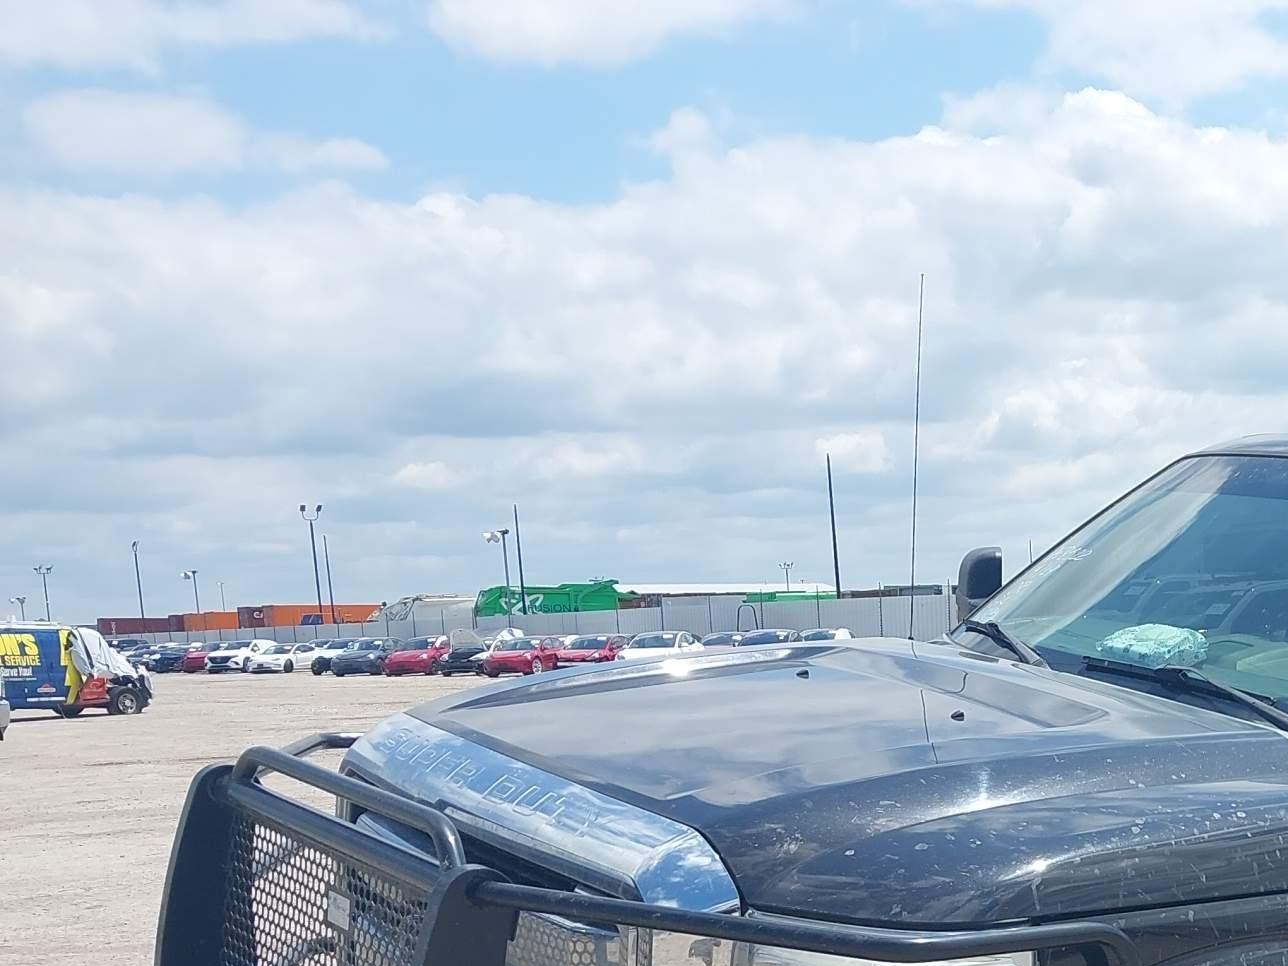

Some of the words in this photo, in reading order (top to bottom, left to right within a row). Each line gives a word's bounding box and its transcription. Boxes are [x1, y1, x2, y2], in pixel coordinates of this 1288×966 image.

[5, 655, 41, 667] SERVICE
[381, 727, 486, 790] SUPER
[481, 773, 600, 838] DUTY
